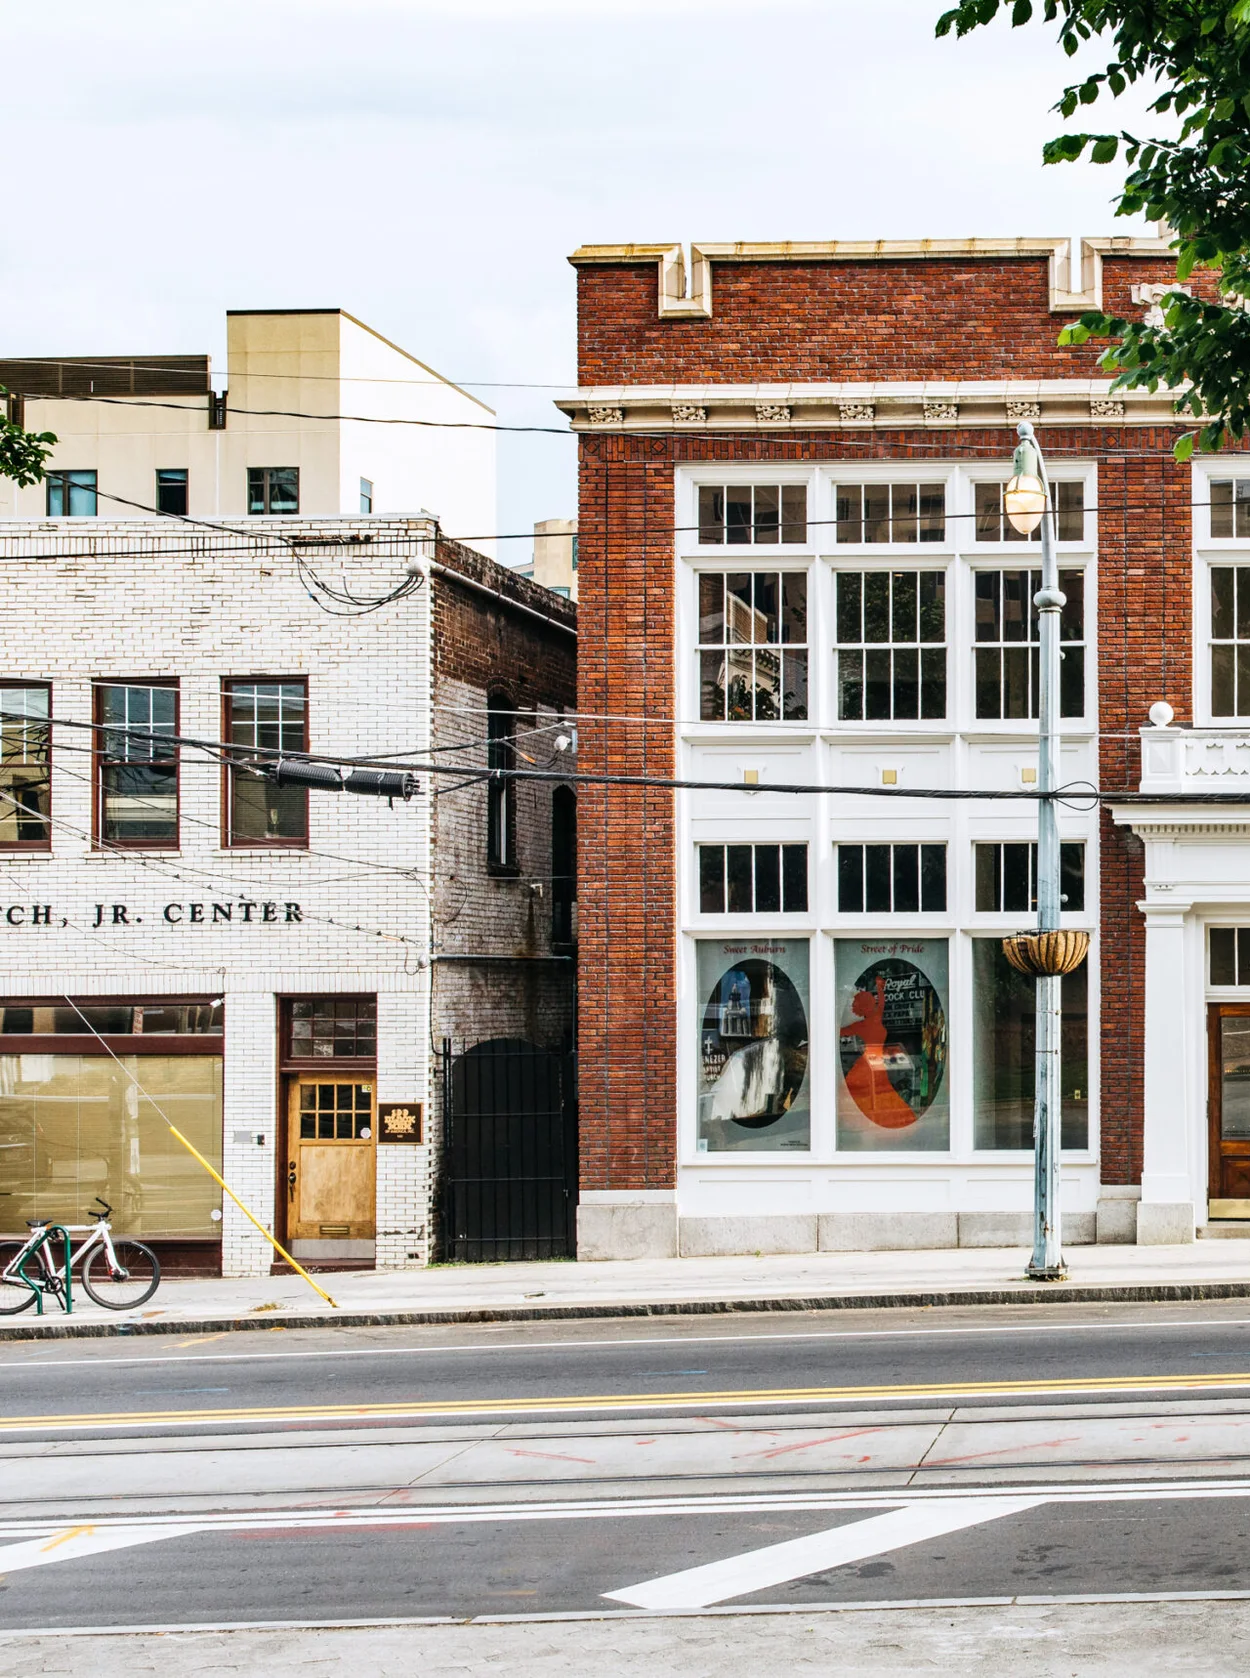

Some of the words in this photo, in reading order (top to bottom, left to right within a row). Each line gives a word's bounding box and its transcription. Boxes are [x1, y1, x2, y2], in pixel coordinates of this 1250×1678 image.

[0, 904, 69, 928] CH,
[92, 904, 142, 928] JR.
[163, 902, 304, 924] CENTER
[723, 944, 747, 954] Sweet
[751, 943, 785, 954] Auburn
[861, 943, 885, 954] Street
[888, 942, 898, 957] of
[900, 943, 924, 954] Pride
[884, 974, 917, 992] Royal
